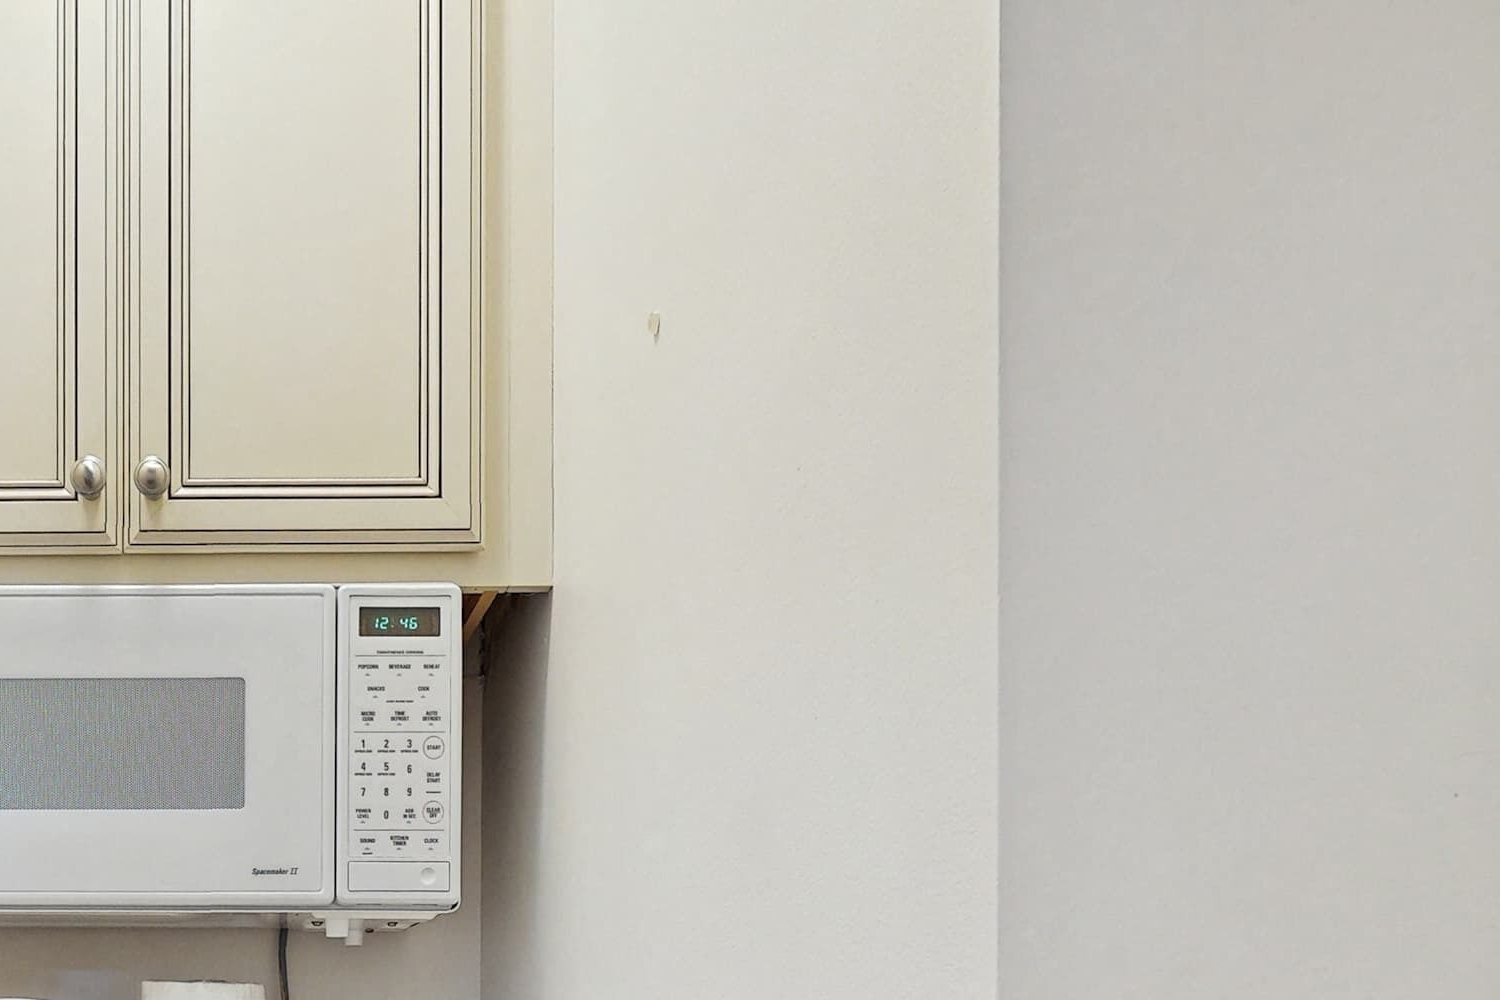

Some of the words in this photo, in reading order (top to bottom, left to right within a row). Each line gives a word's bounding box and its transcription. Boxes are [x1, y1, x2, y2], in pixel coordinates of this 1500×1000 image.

[361, 739, 366, 748] 1
[383, 739, 390, 748] 2
[407, 739, 413, 748] 3
[361, 762, 367, 771] 4
[384, 762, 390, 771] 5
[407, 764, 413, 773] 6
[361, 787, 366, 797] 7
[384, 787, 389, 796] 8
[407, 787, 412, 796] 9
